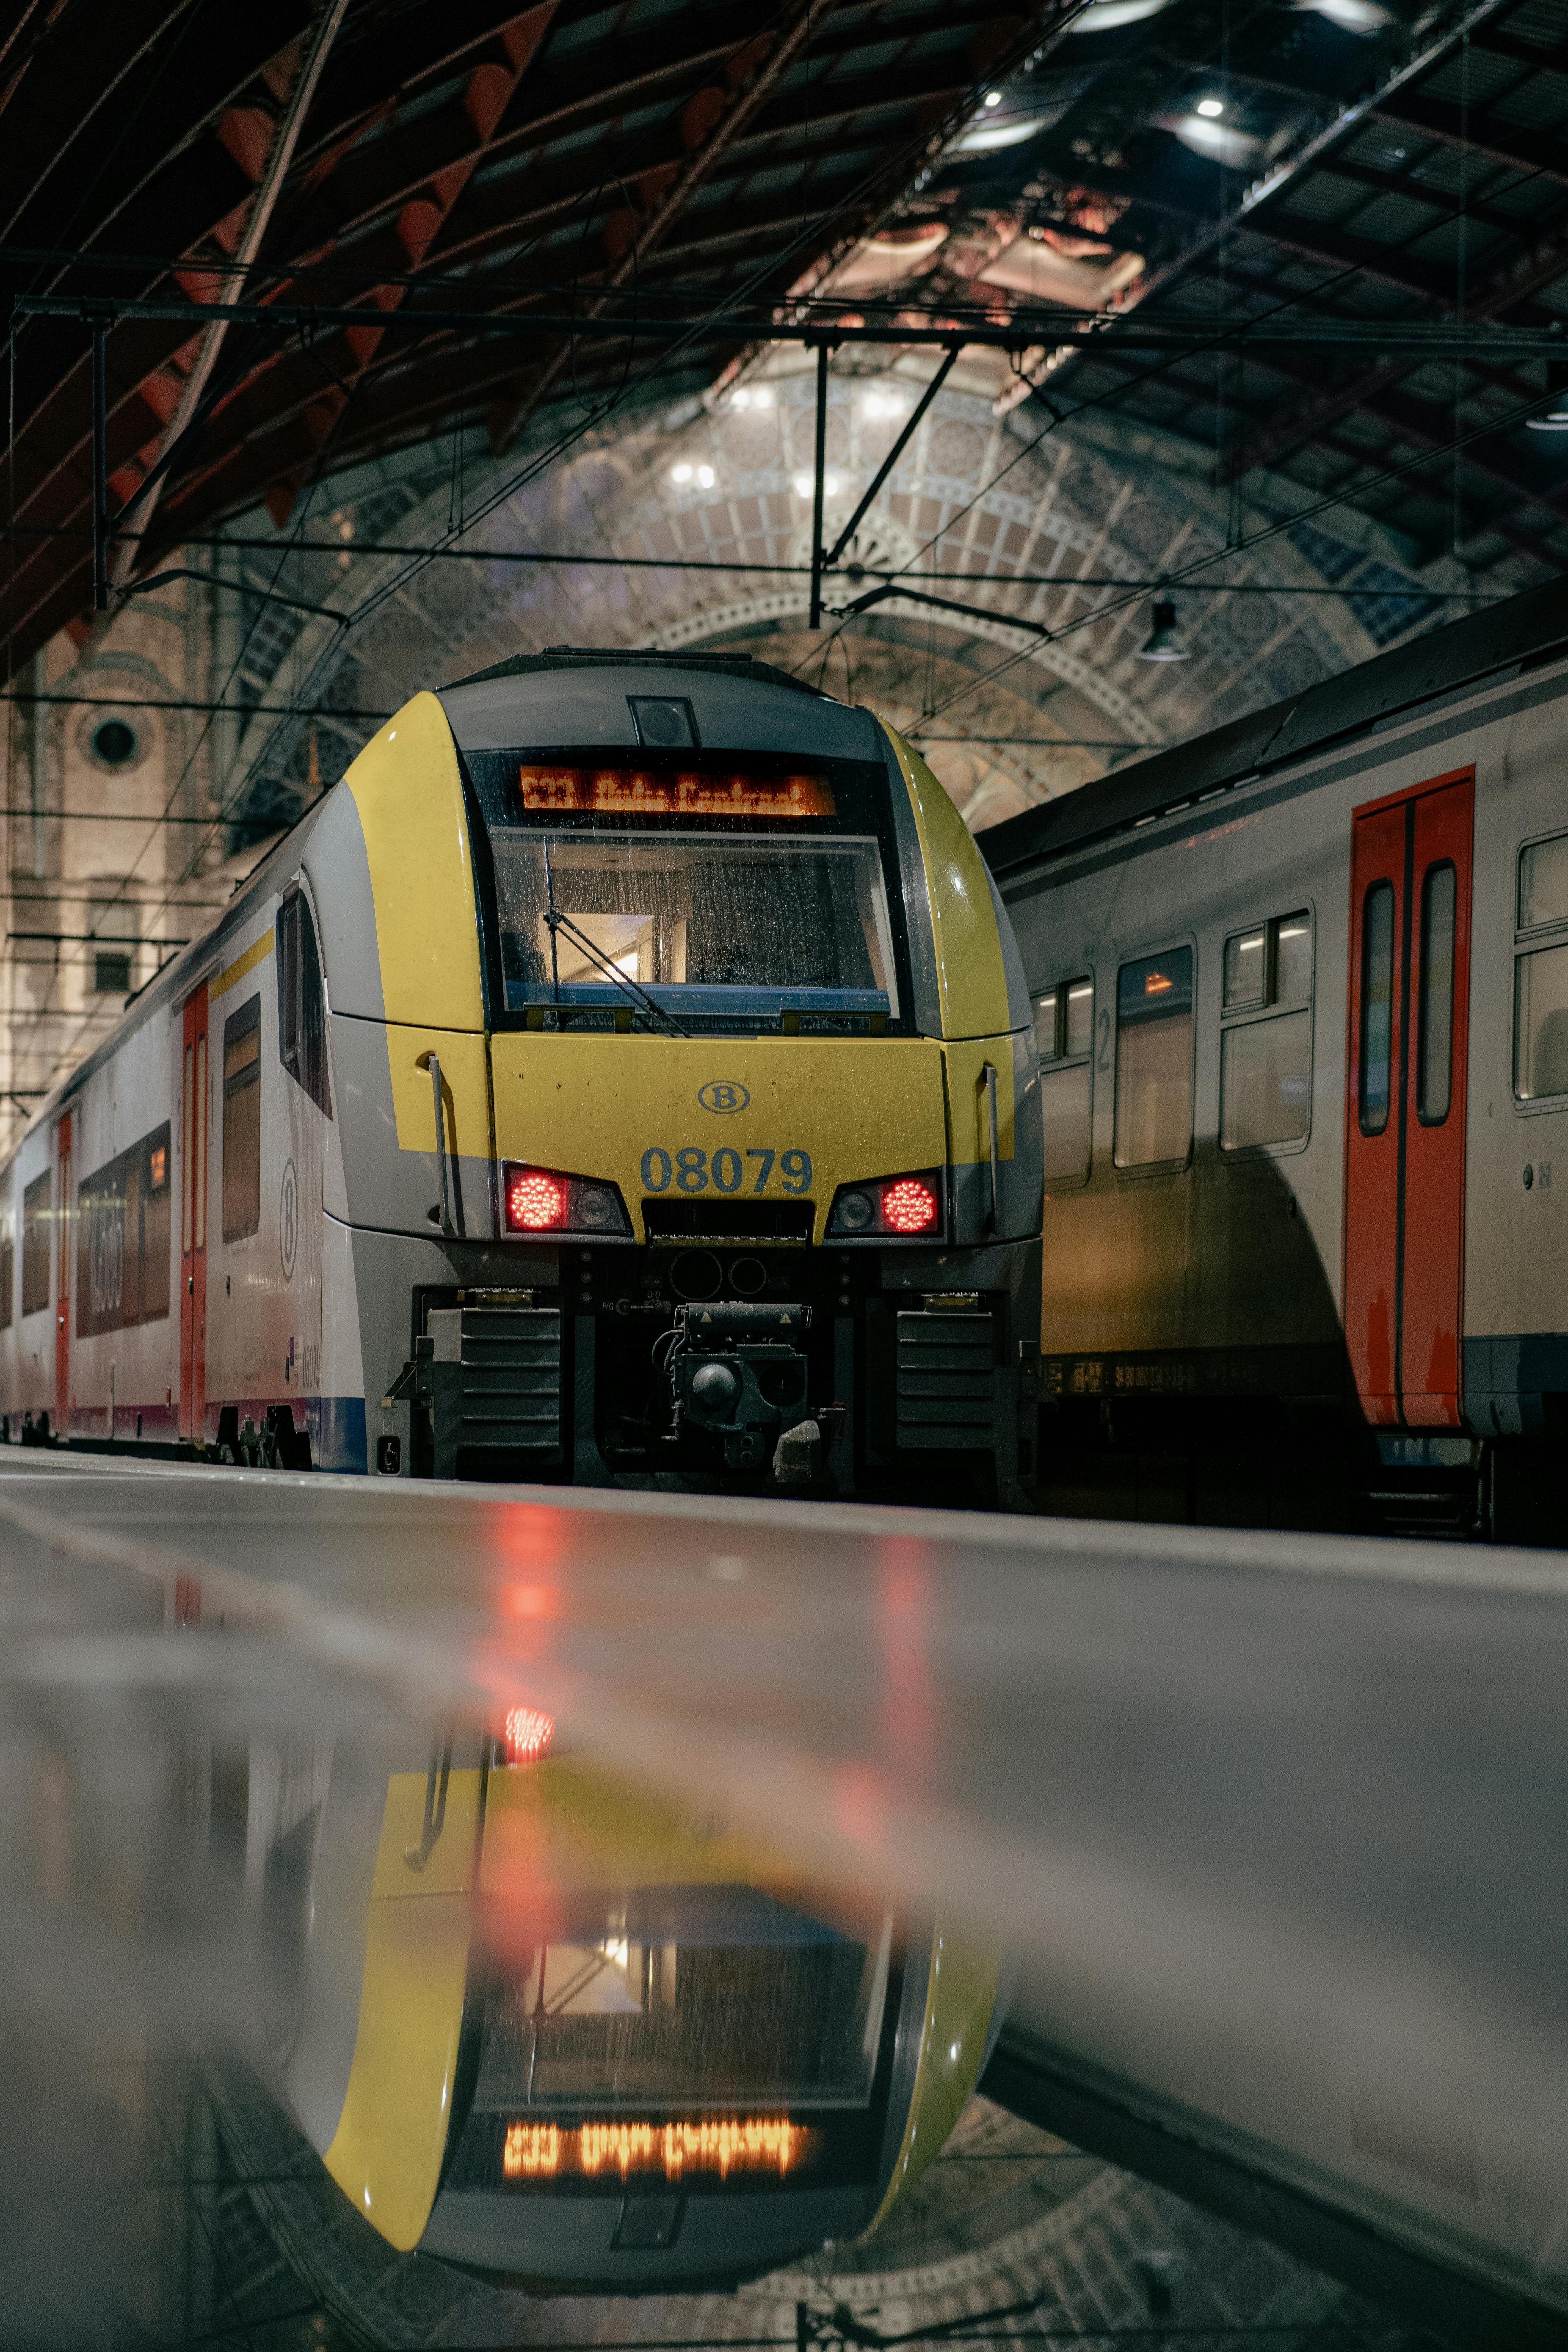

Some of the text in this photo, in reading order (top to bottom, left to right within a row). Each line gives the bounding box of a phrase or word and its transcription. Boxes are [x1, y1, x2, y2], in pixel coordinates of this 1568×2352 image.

[1099, 1009, 1110, 1072] 2
[711, 1085, 737, 1109] B
[640, 1147, 813, 1194] 08079
[603, 1302, 614, 1310] F/G
[303, 1344, 320, 1388] 08079
